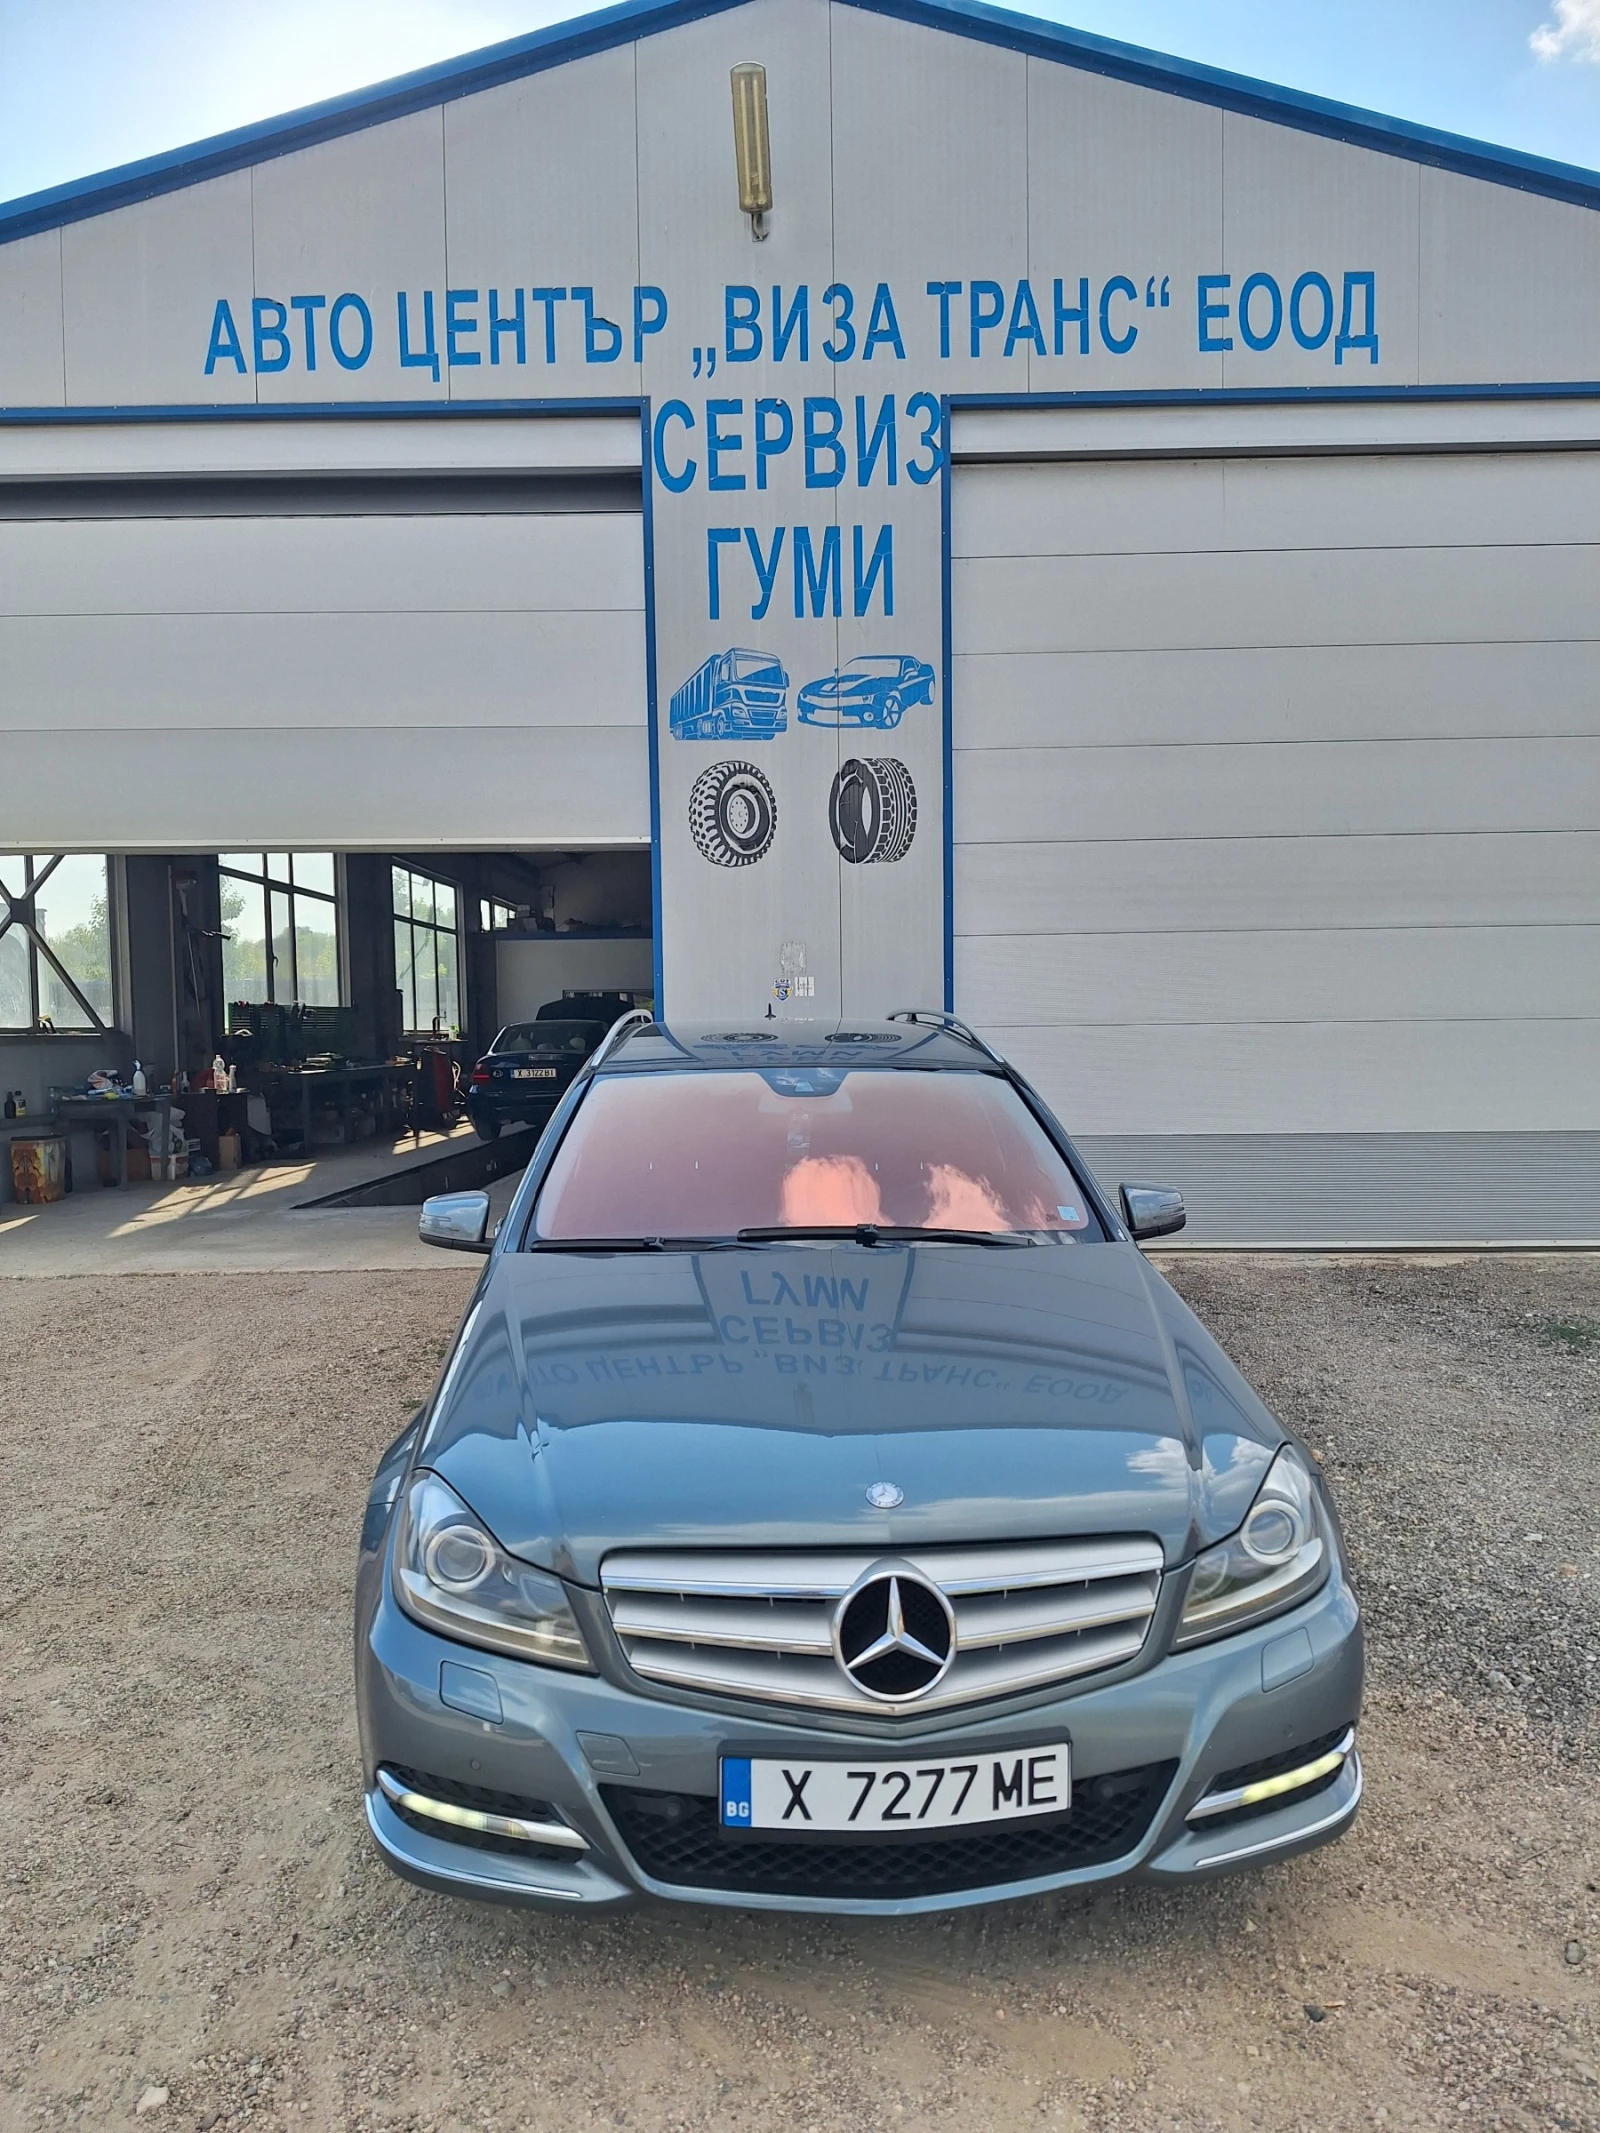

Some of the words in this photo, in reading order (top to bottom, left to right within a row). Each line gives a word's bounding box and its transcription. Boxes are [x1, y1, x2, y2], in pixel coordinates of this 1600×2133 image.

[204, 294, 373, 374] АВТО
[398, 286, 668, 383] ЦЕНТЪР
[692, 283, 906, 379] „ВИЗА
[926, 275, 1170, 359] ТРАНС“
[1197, 271, 1379, 365] ЕООД
[653, 392, 943, 494] СЕРВИЗ
[707, 525, 893, 620] ГУМИ
[726, 1801, 749, 1818] BG
[781, 1769, 812, 1821] X
[847, 1763, 978, 1822] 7277
[992, 1754, 1057, 1811] ME
